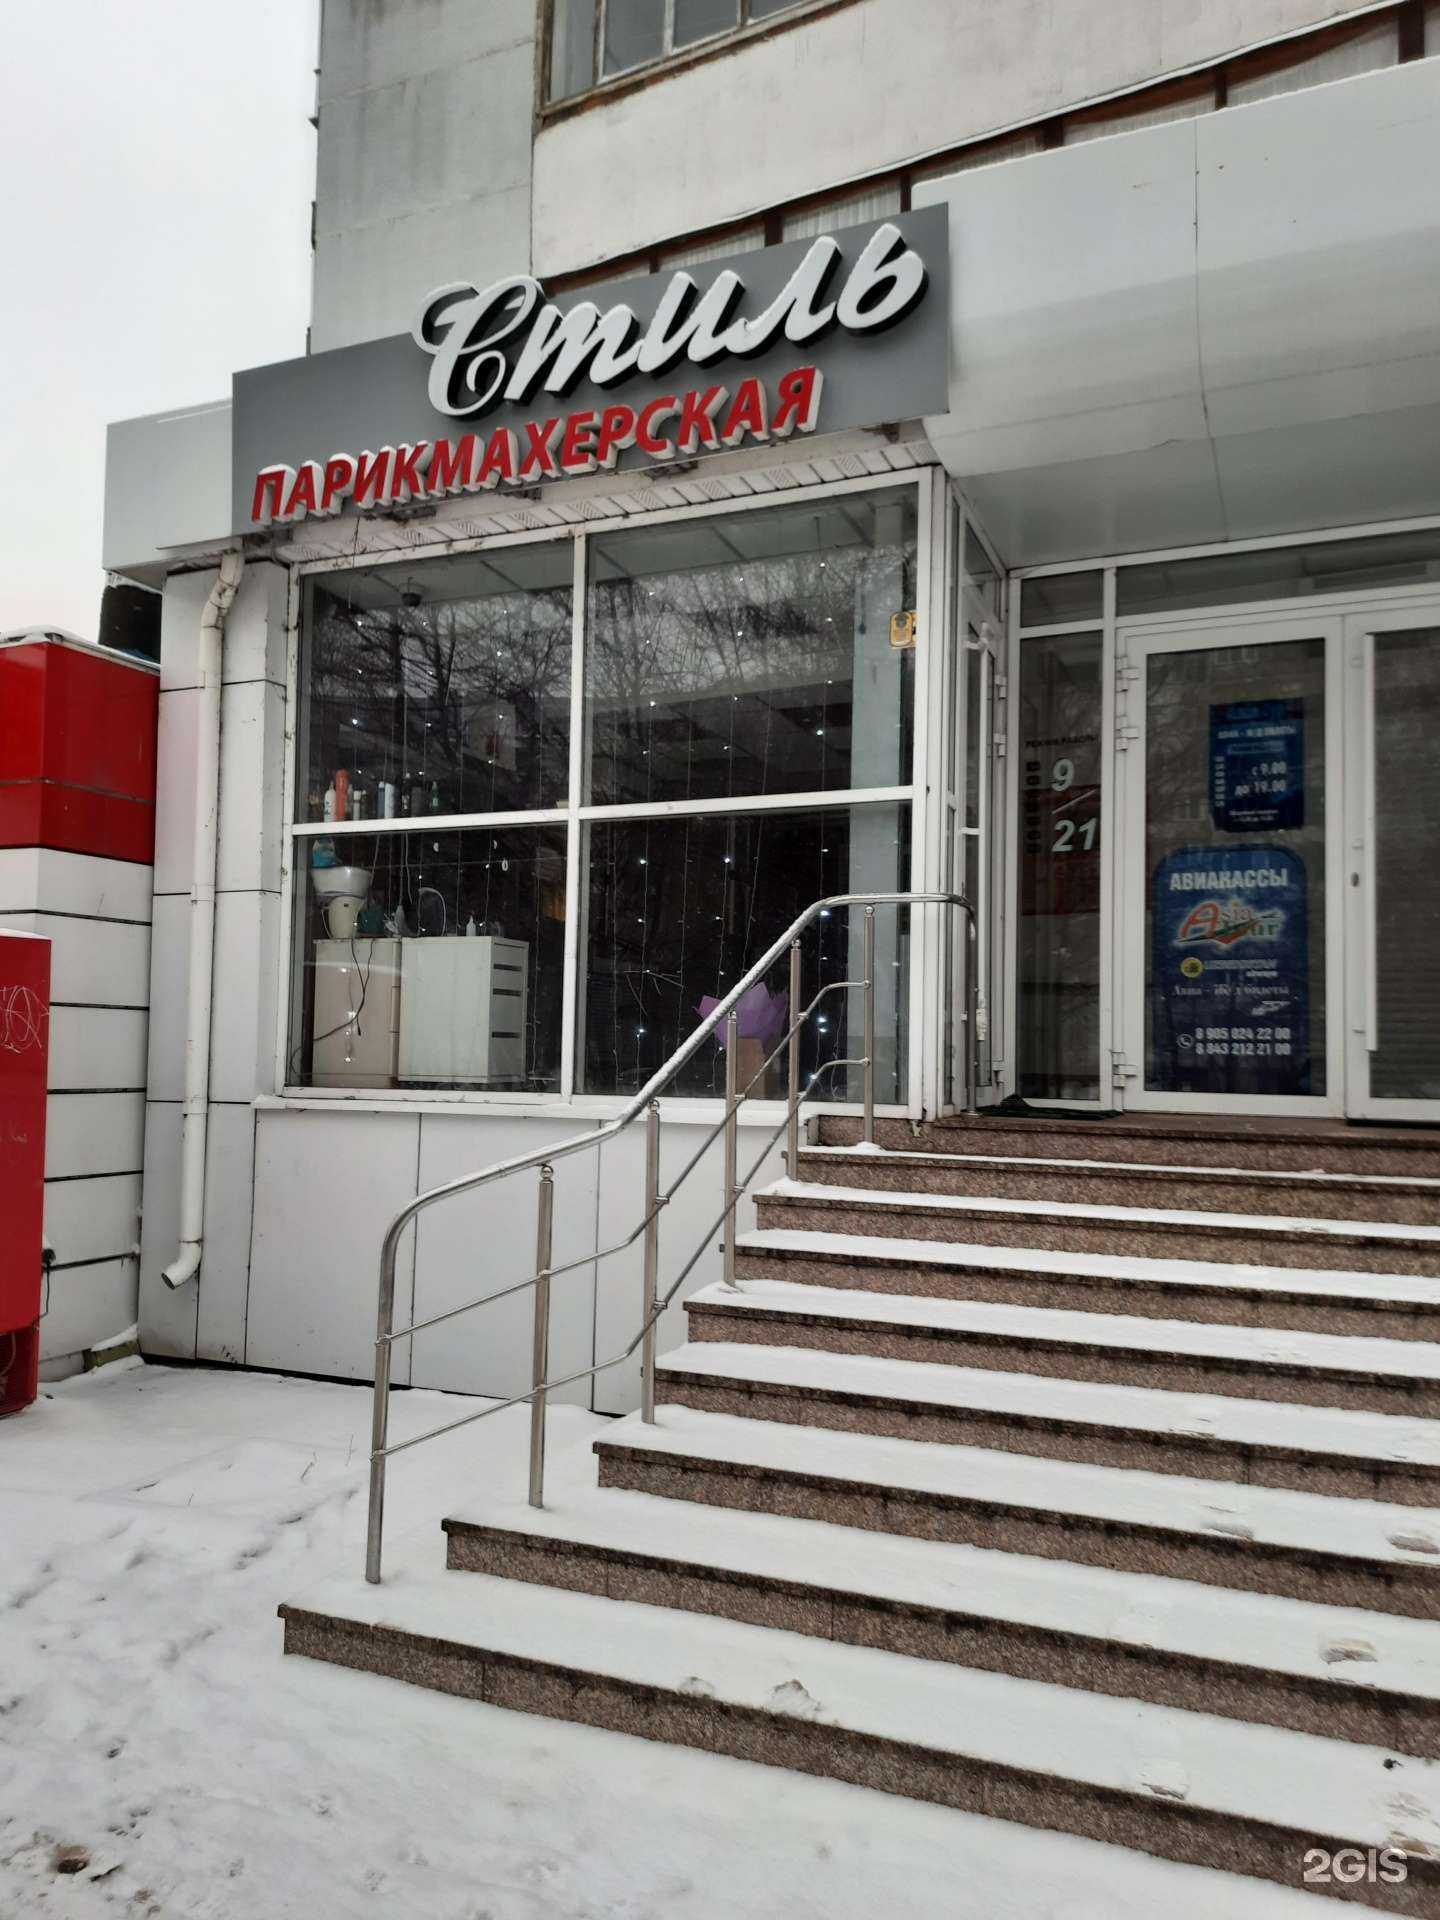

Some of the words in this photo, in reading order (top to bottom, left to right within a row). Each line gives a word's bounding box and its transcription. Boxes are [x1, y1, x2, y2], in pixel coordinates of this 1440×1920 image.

[411, 222, 930, 420] Стиль
[251, 366, 823, 525] ПАРИКМАХЕРСКАЯ
[1050, 758, 1075, 792] 9
[1052, 818, 1097, 852] 21
[1169, 867, 1288, 891] АВИАКАССЫ
[1194, 1027, 1205, 1040] 8
[1256, 1027, 1273, 1040] 22
[1194, 1042, 1205, 1055] 8
[1230, 1042, 1255, 1055] 212
[1256, 1042, 1272, 1055] 21
